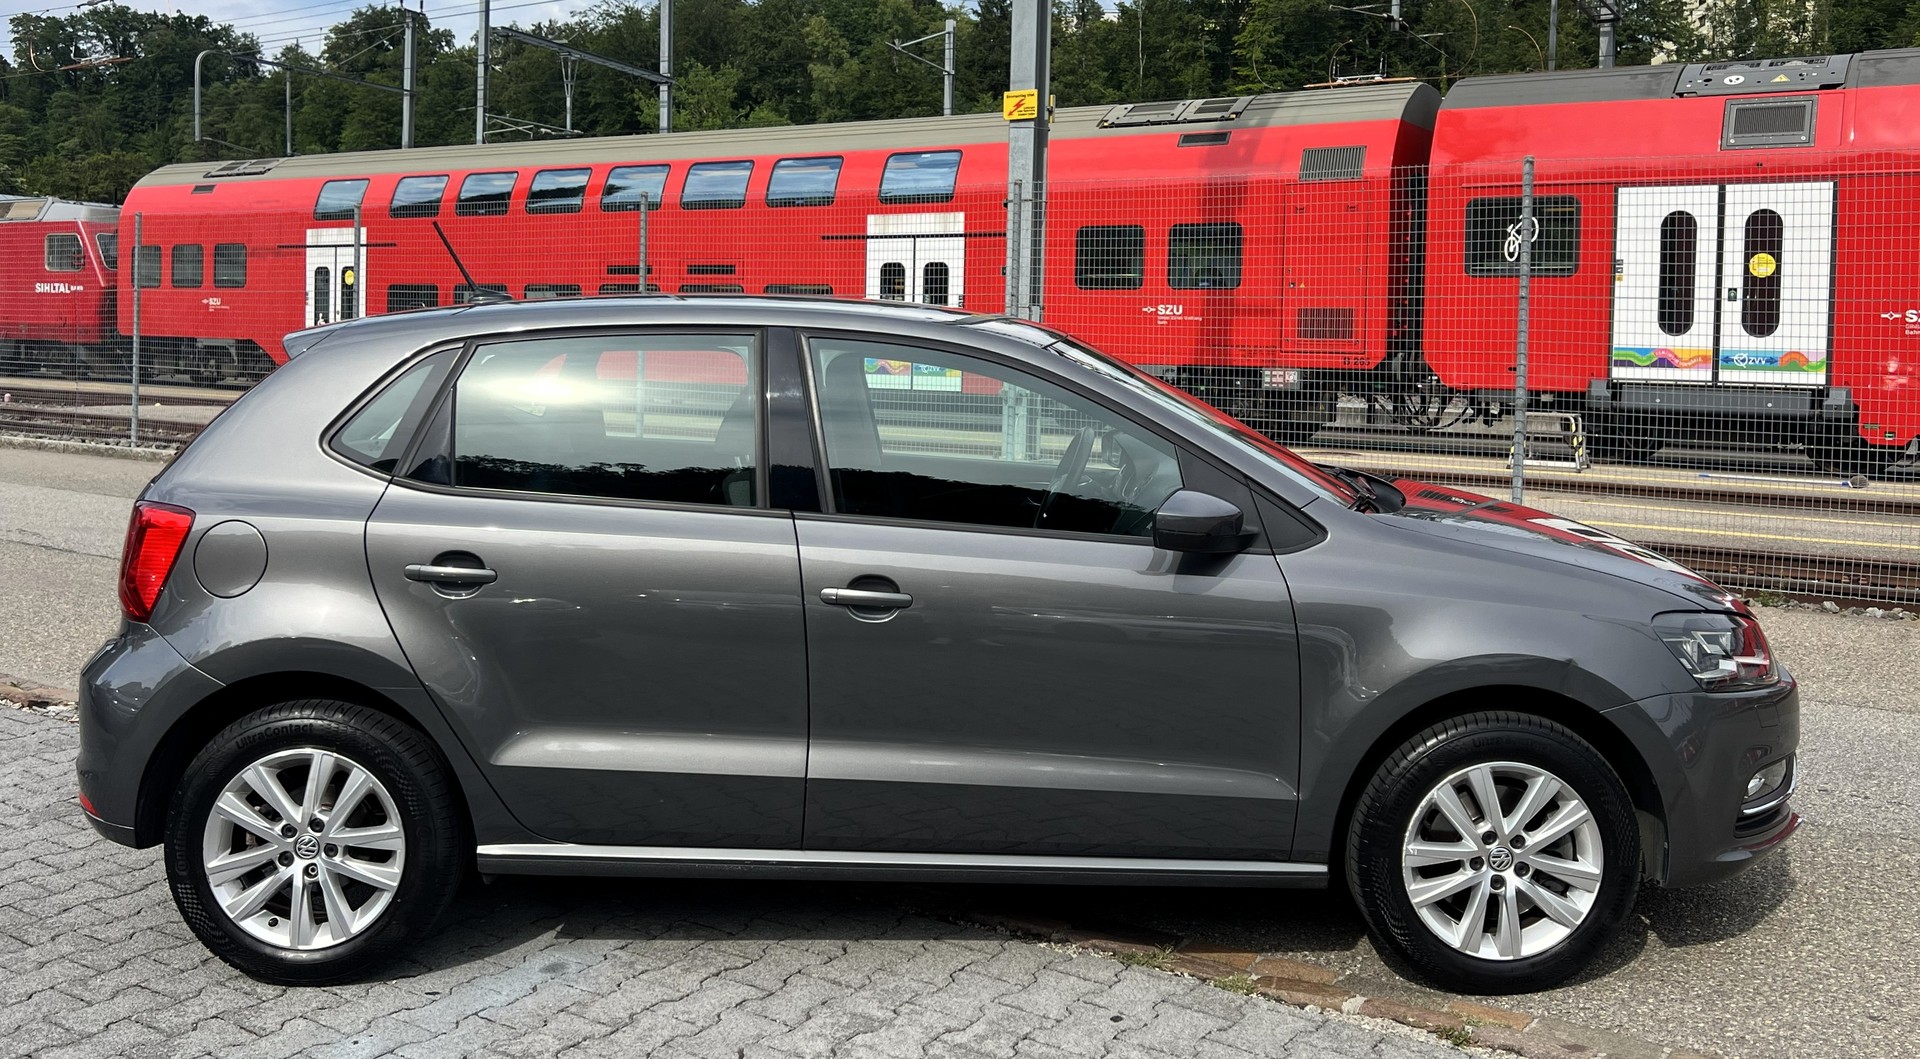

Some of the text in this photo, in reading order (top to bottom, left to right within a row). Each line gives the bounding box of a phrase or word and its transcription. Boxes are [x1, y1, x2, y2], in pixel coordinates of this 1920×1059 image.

[35, 282, 71, 293] SIHLTAL
[1157, 304, 1183, 315] SZU
[1905, 309, 1920, 323] S
[235, 723, 314, 749] UltraContact
